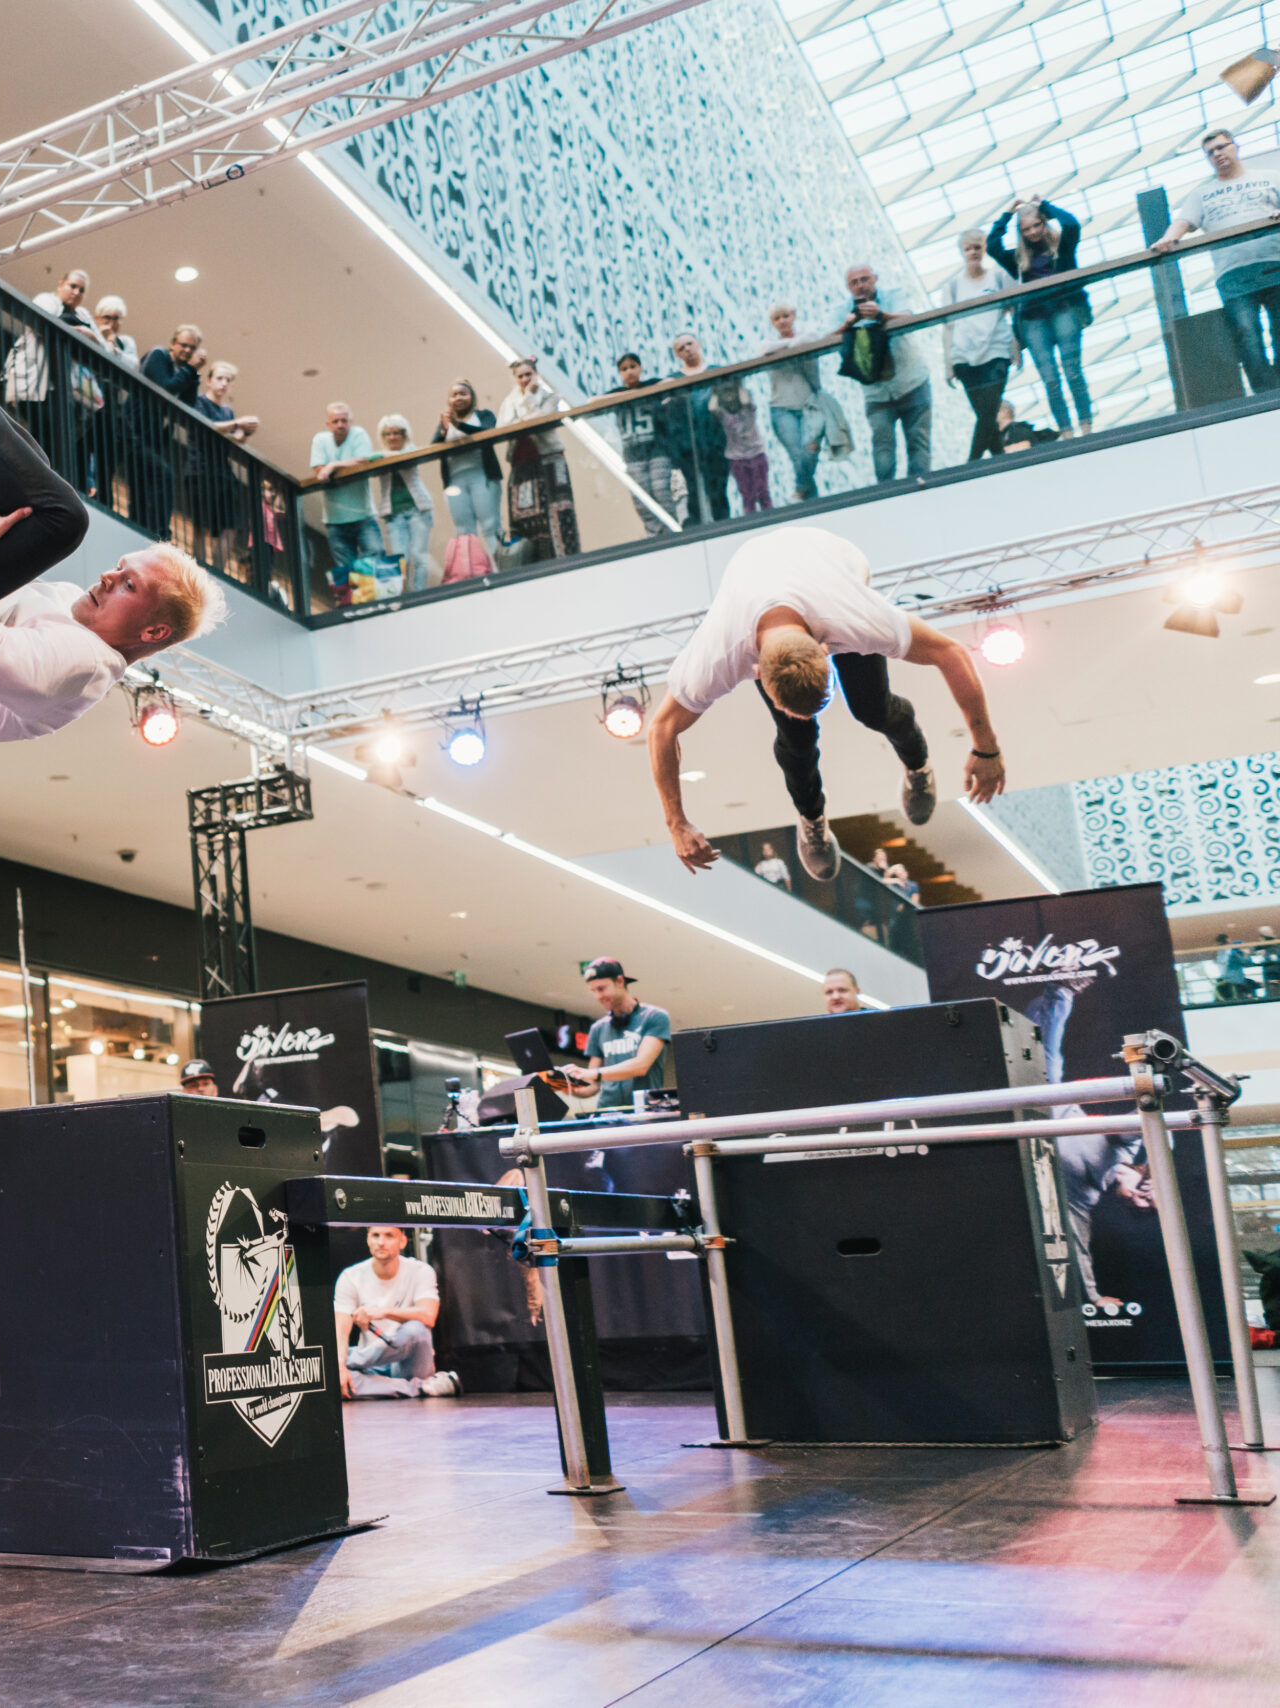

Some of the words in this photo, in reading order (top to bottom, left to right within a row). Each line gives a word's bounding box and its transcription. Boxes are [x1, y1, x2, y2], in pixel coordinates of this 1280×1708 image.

[1202, 185, 1232, 201] CAMP
[1236, 181, 1270, 192] DAVID
[247, 1404, 255, 1420] by
[254, 1397, 268, 1416] world
